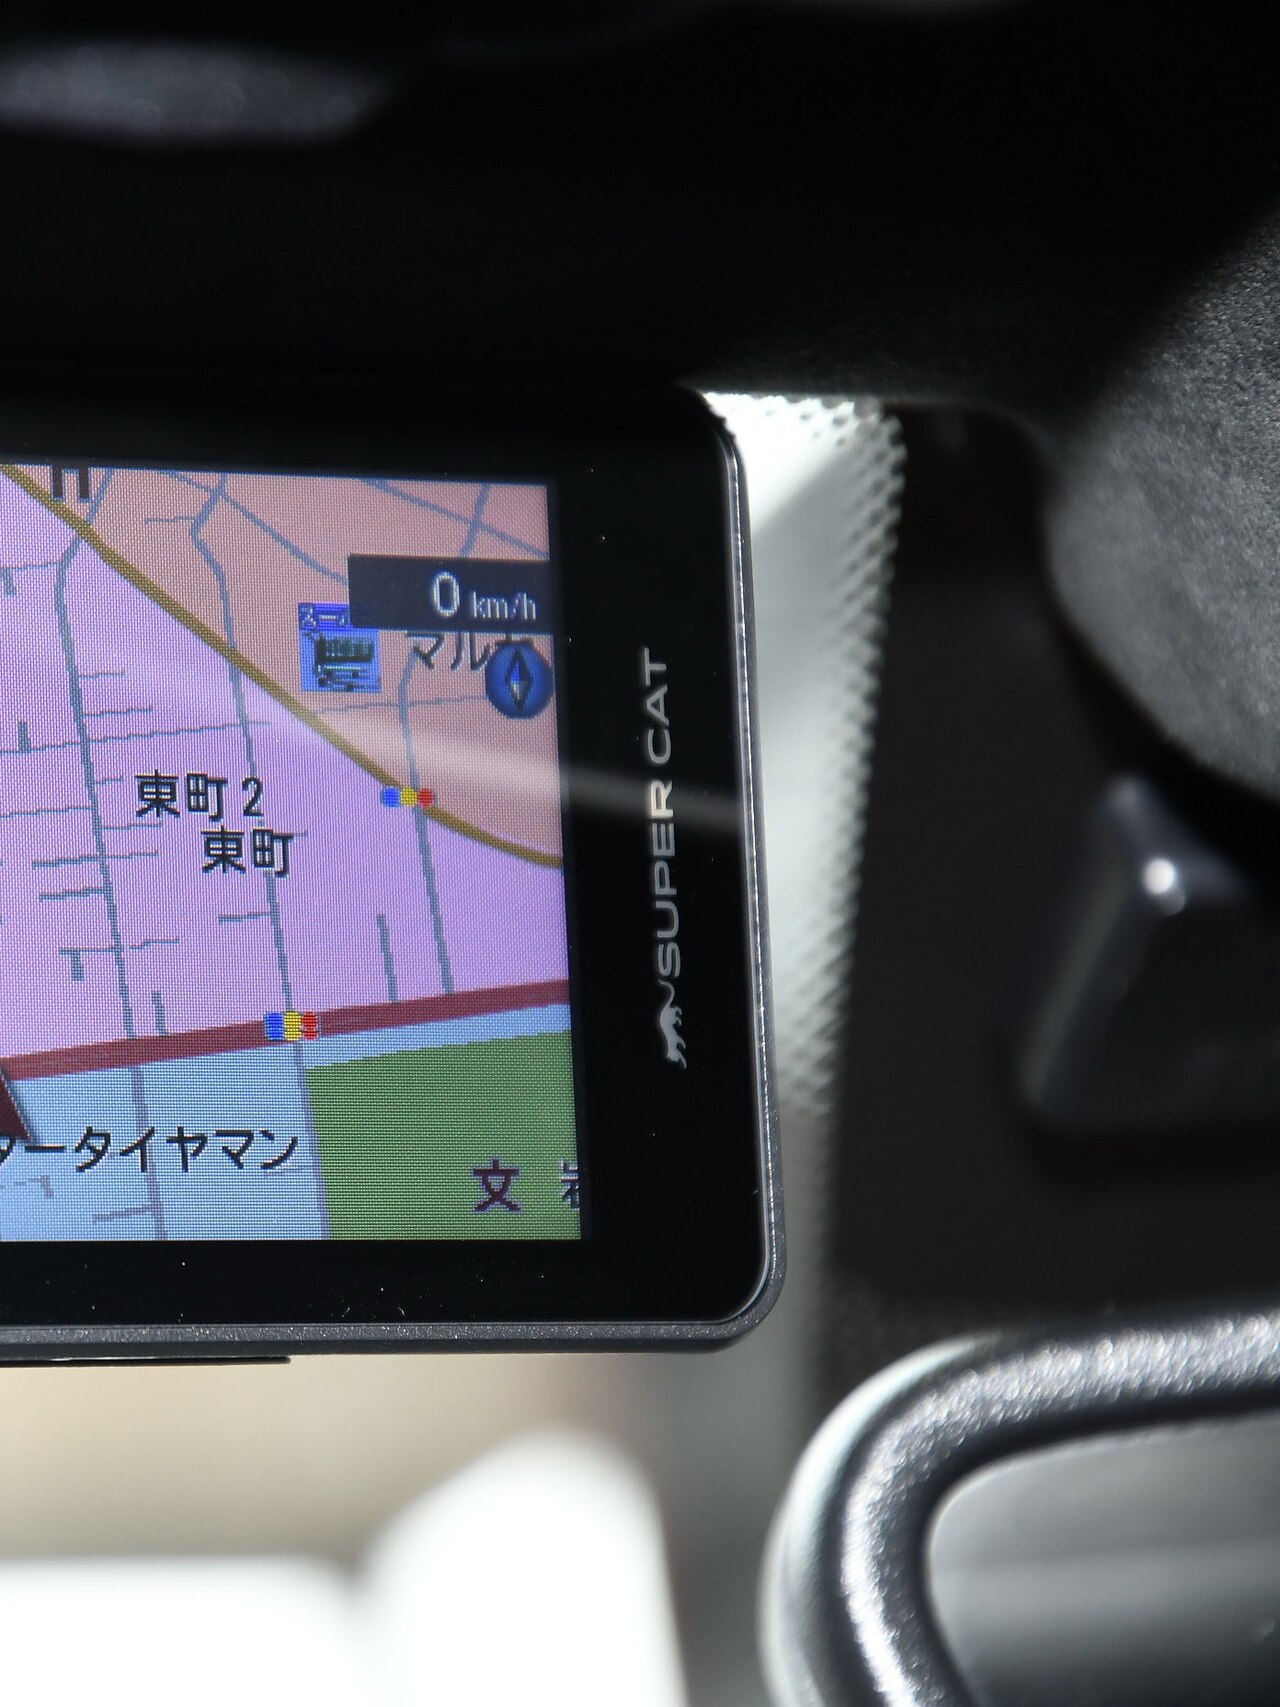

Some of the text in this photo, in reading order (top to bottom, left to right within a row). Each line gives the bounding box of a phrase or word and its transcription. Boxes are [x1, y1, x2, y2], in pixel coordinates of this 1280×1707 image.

[432, 571, 537, 621] 0 km/h
[407, 630, 535, 671] マル
[642, 647, 682, 978] SUPER CAT
[201, 825, 294, 877] 東町
